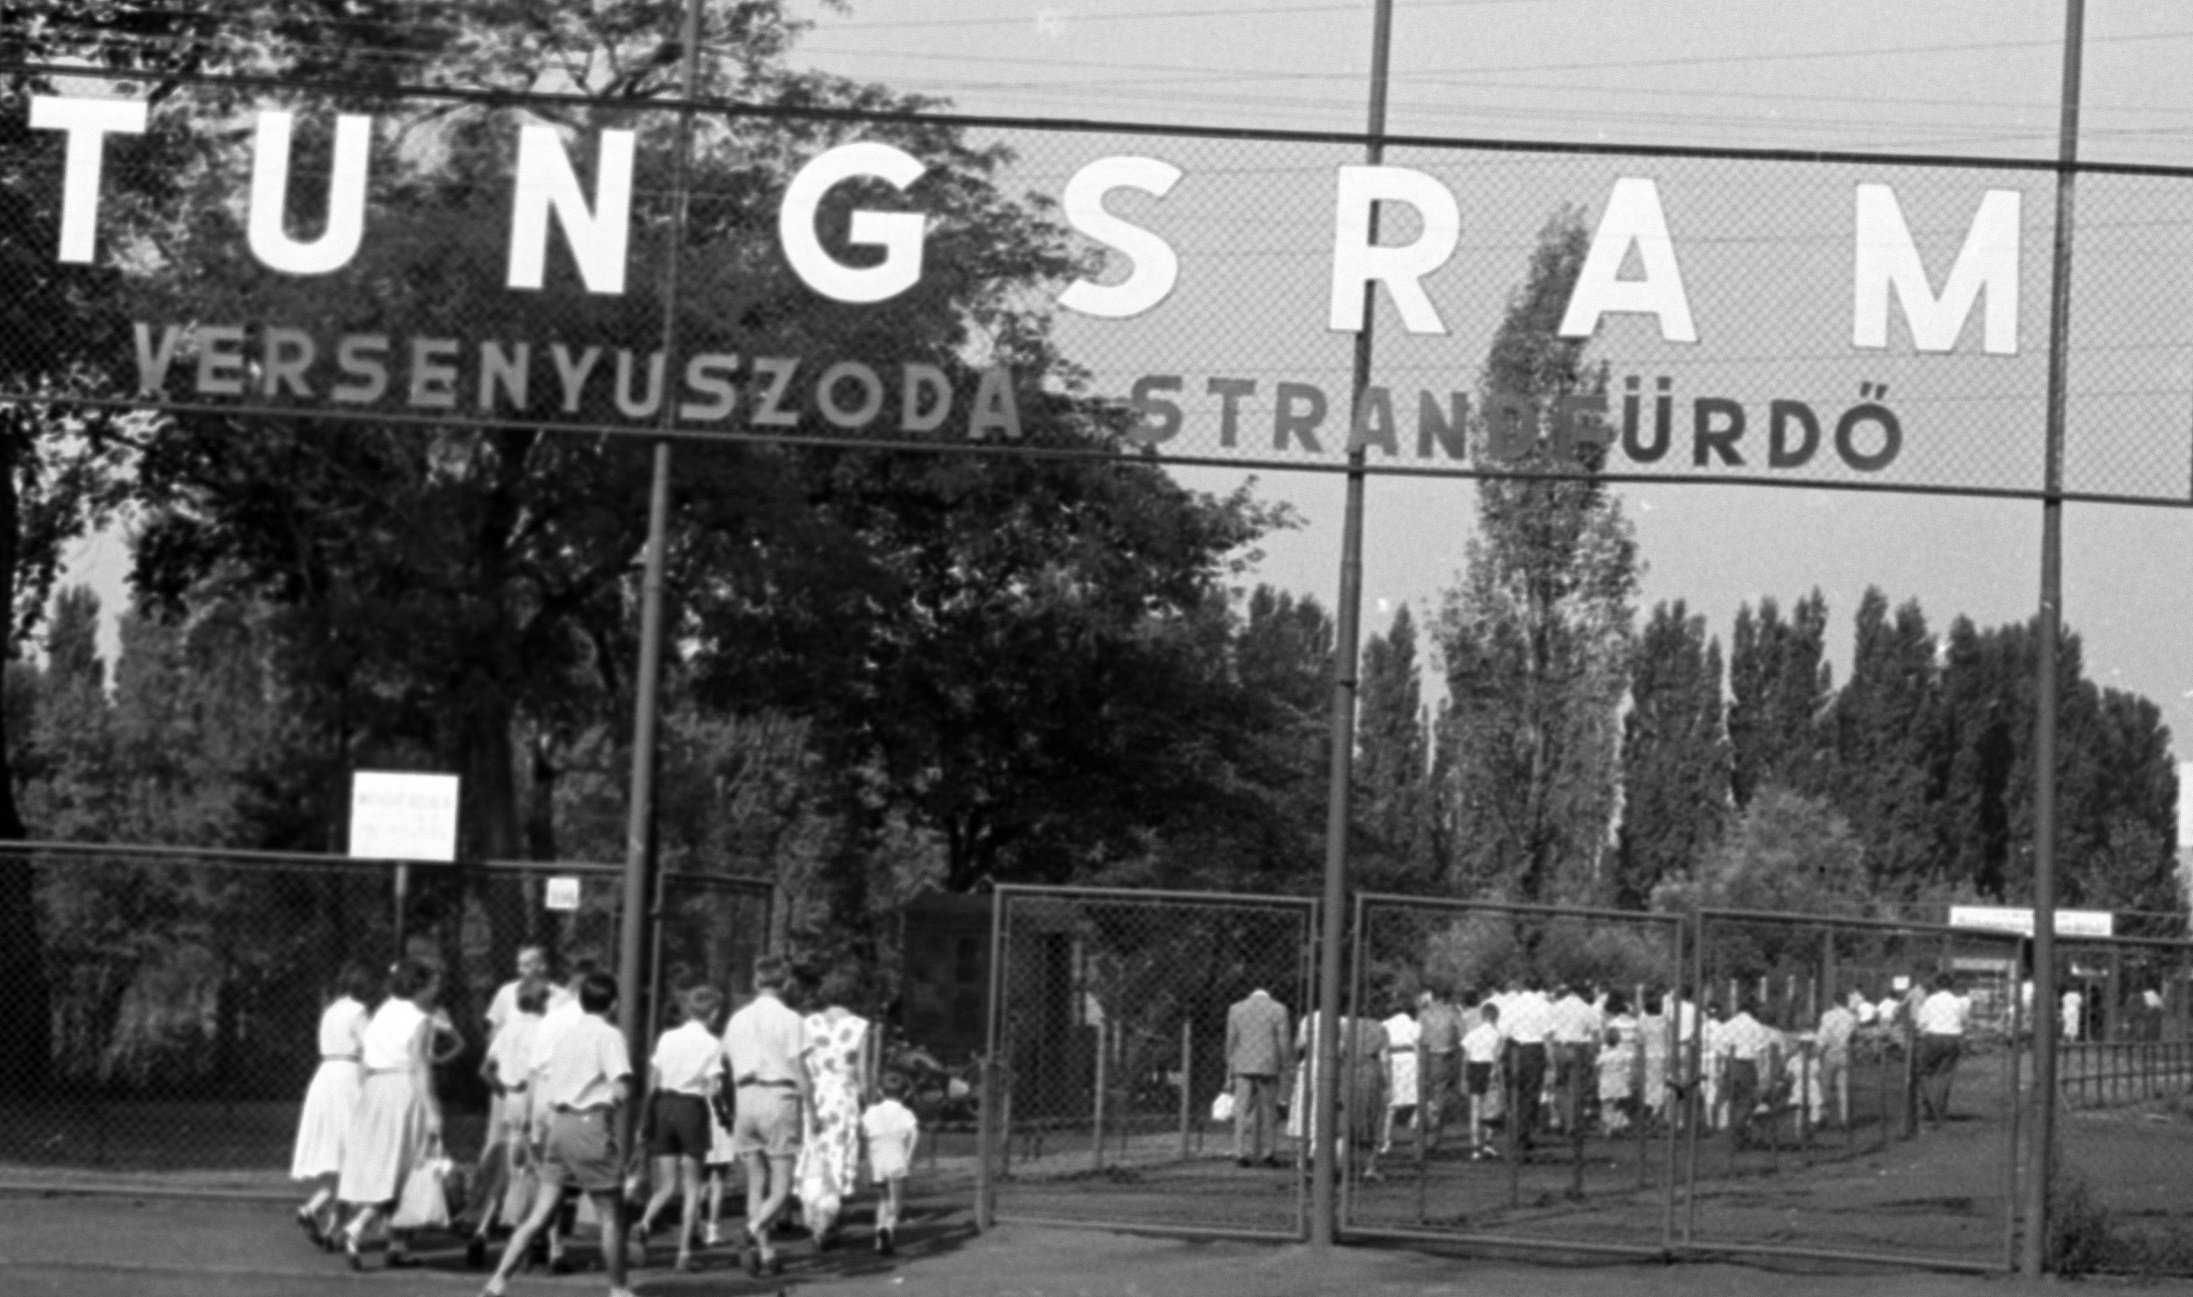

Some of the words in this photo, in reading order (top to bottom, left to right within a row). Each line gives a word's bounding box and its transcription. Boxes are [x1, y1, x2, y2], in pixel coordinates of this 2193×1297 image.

[28, 96, 2022, 355] TUNGSRAM
[133, 321, 1023, 440] VERSENYUSZODA
[1129, 374, 1902, 473] STRANDFÜRDŐ
